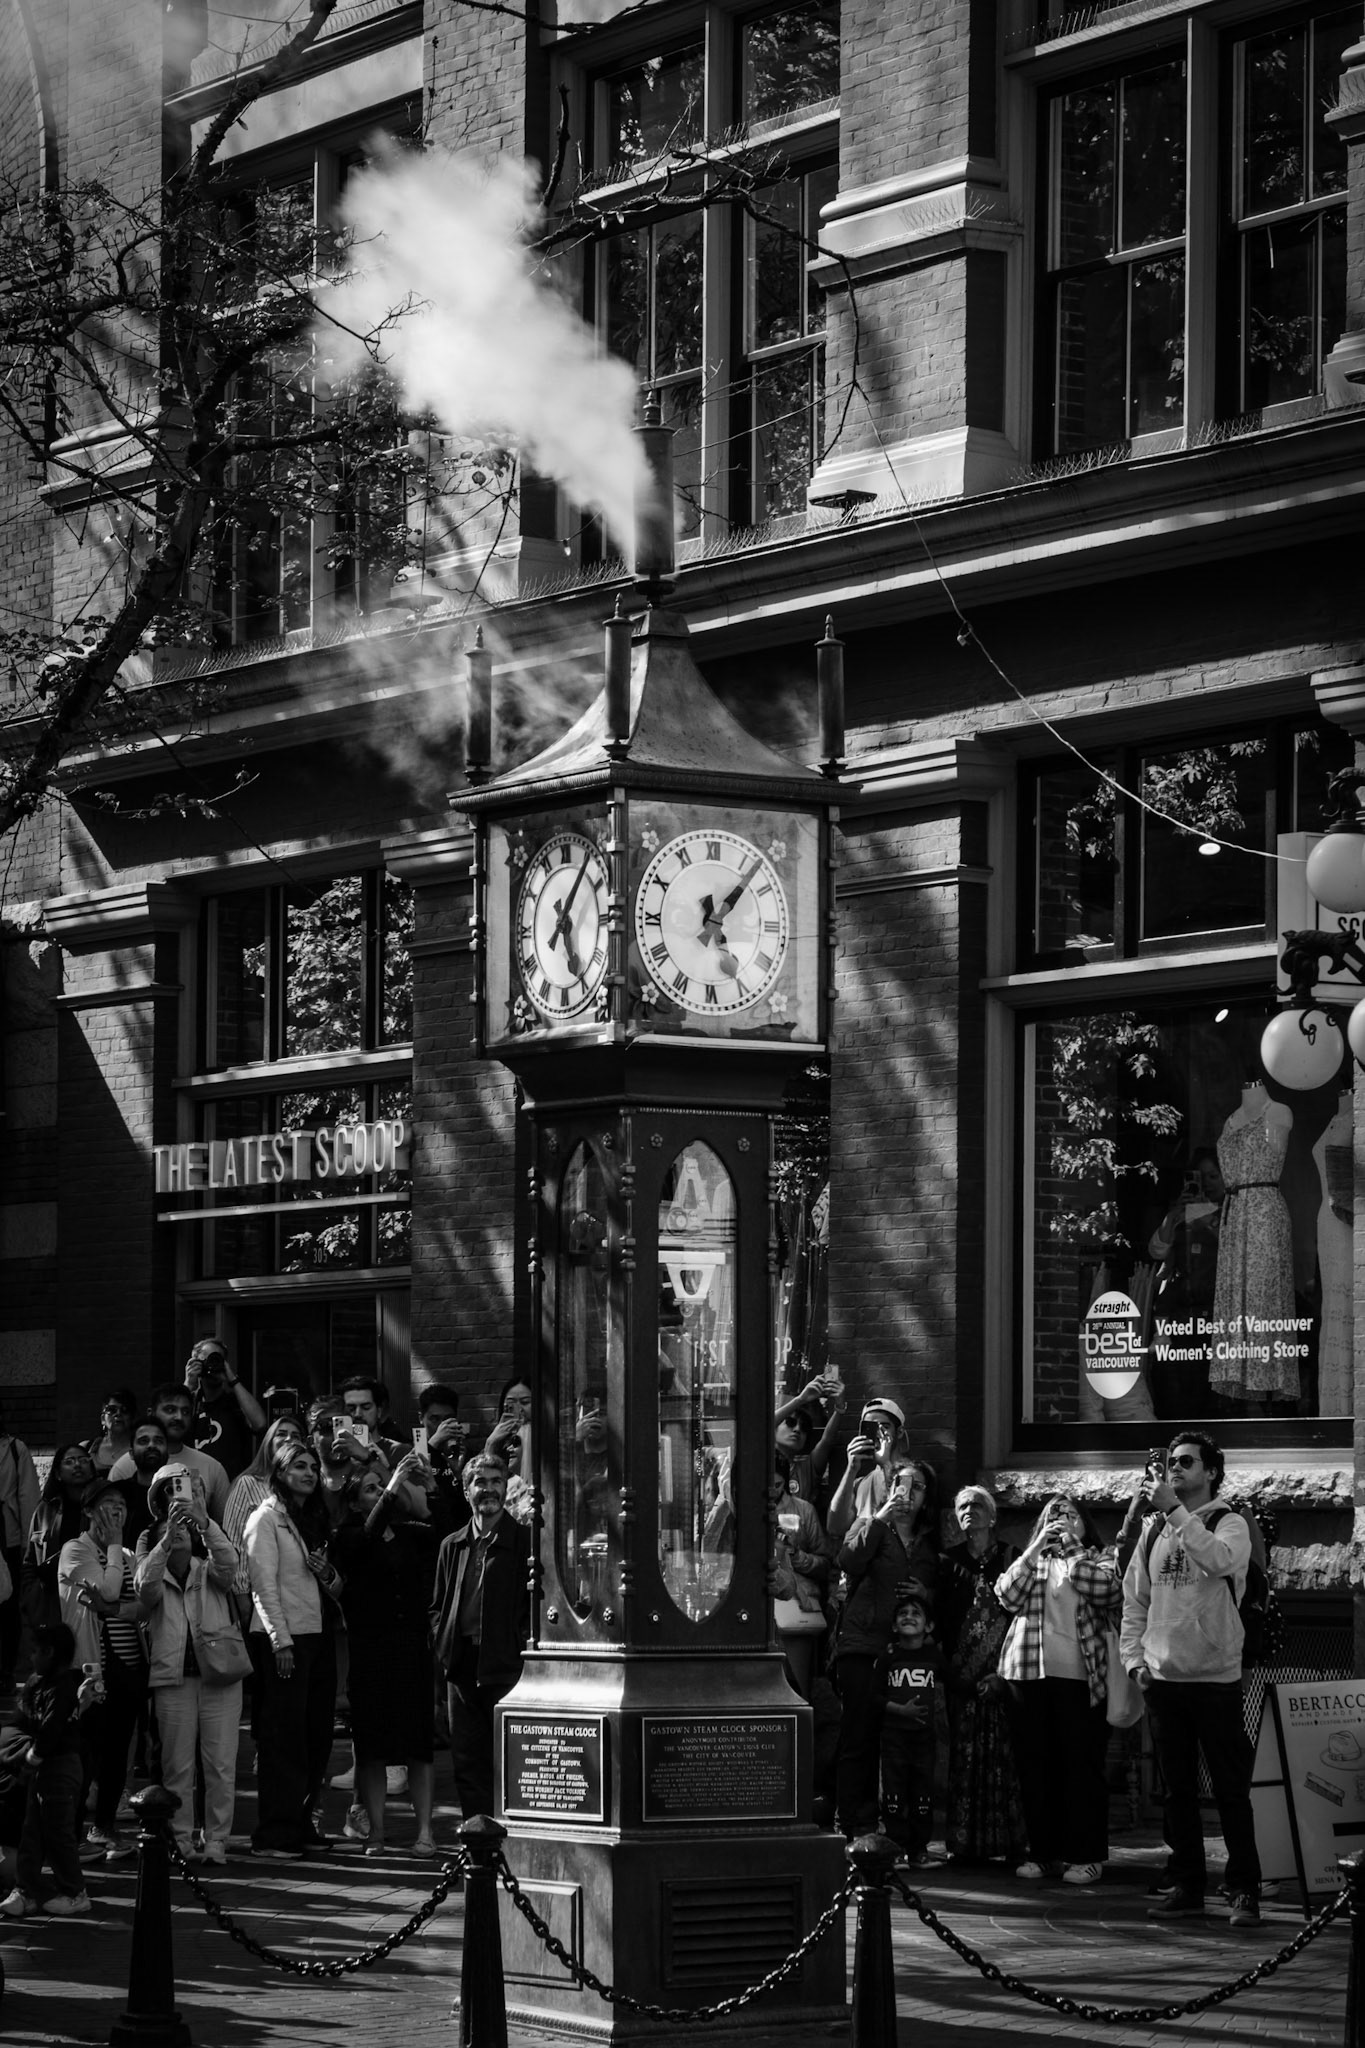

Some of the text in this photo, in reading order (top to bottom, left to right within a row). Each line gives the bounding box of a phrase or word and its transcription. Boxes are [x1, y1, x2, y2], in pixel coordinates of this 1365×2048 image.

[652, 873, 671, 892] X
[153, 1120, 410, 1193] THE LATEST SCOOP
[313, 1247, 328, 1264] 305
[1093, 1301, 1130, 1314] straight
[1103, 1321, 1126, 1330] ANNUAL
[1155, 1315, 1314, 1336] Voted Best of Vancouver
[1078, 1321, 1148, 1355] best of
[1155, 1340, 1309, 1363] Women's Clothing Store
[1085, 1356, 1141, 1369] vancouver
[888, 1668, 934, 1688] NASA
[1290, 1709, 1353, 1719] HANDMADE
[510, 1725, 597, 1737] THE GASTOWN STEAM CLOCK
[651, 1724, 787, 1735] GASTOWN STEAM CLOCK SPONSORS
